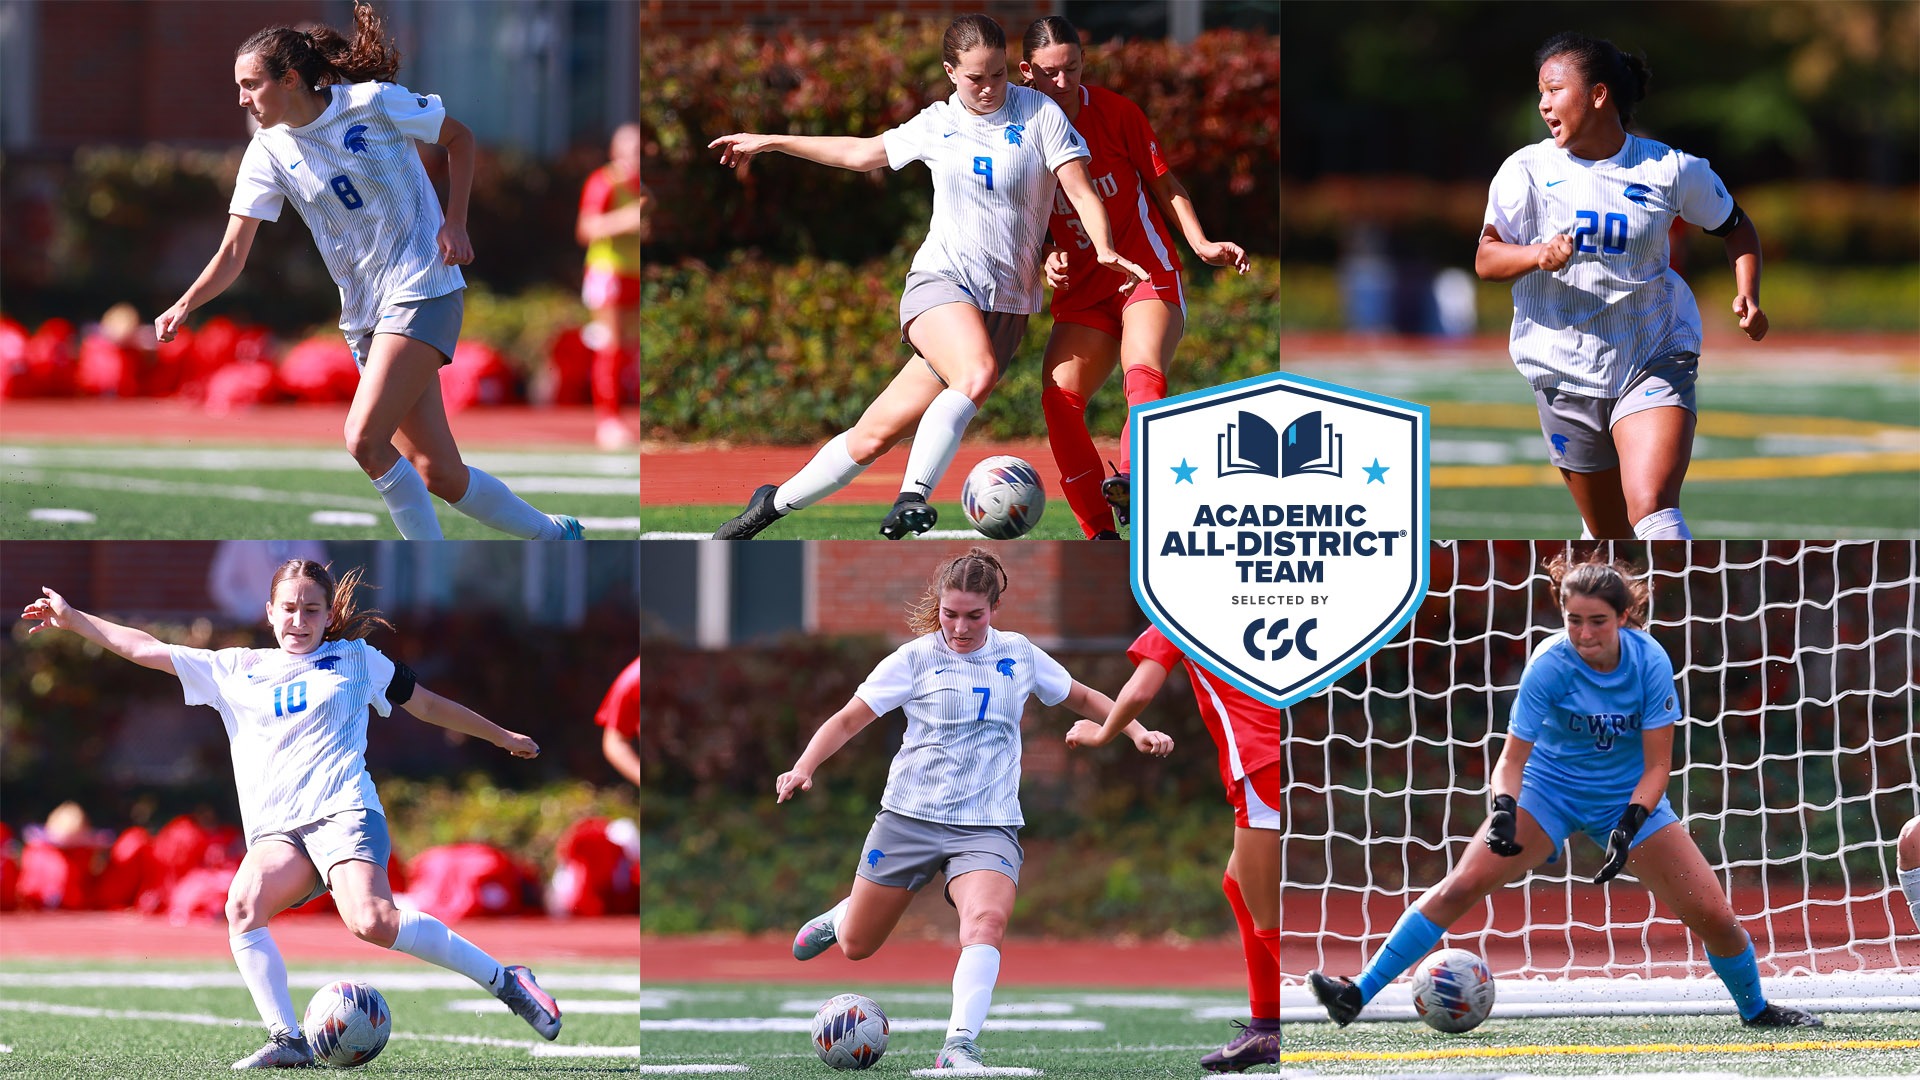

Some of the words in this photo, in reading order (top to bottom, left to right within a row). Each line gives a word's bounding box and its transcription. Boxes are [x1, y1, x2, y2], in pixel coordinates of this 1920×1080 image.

[973, 156, 994, 190] 9
[331, 174, 363, 210] 8
[1575, 210, 1628, 255] 20
[273, 680, 307, 718] 10
[971, 687, 991, 722] 7
[1569, 713, 1642, 736] CWRU
